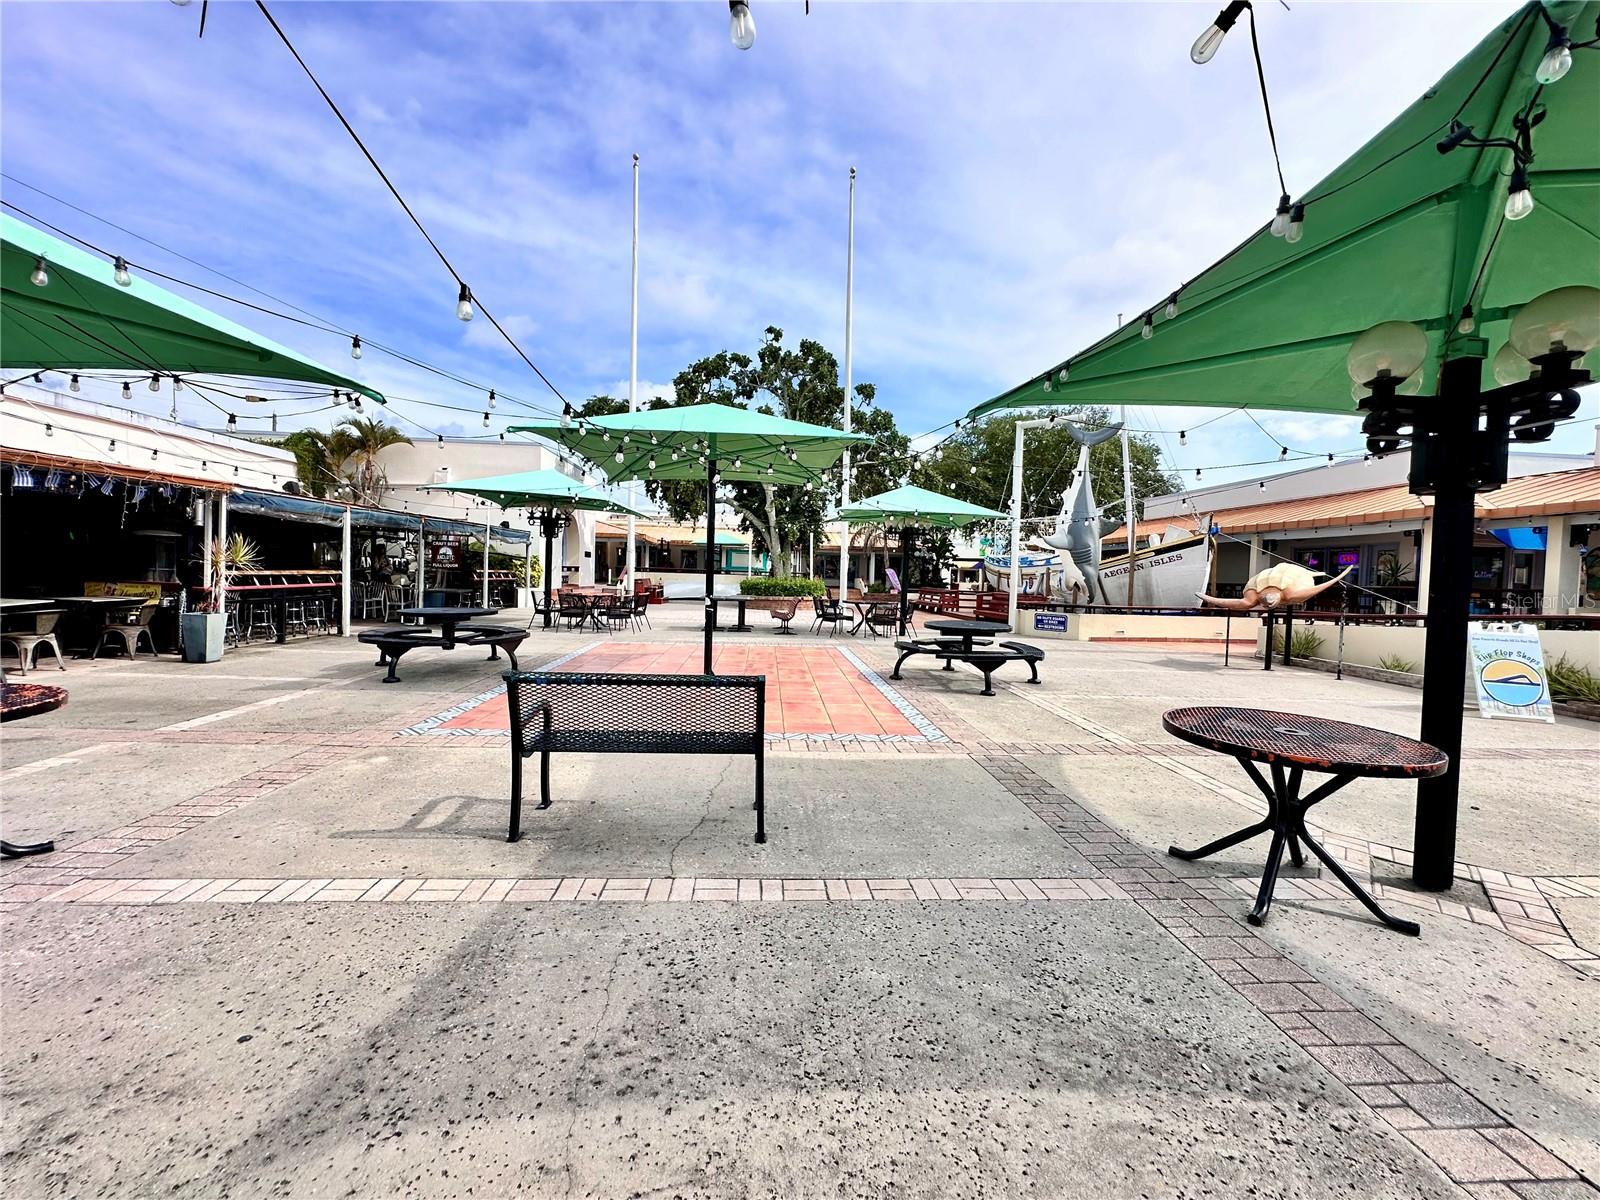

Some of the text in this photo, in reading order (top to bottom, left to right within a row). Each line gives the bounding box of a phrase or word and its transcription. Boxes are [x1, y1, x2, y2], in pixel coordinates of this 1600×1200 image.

[1149, 553, 1183, 567] ISLES
[1476, 648, 1541, 666] Flip Flop Shops
